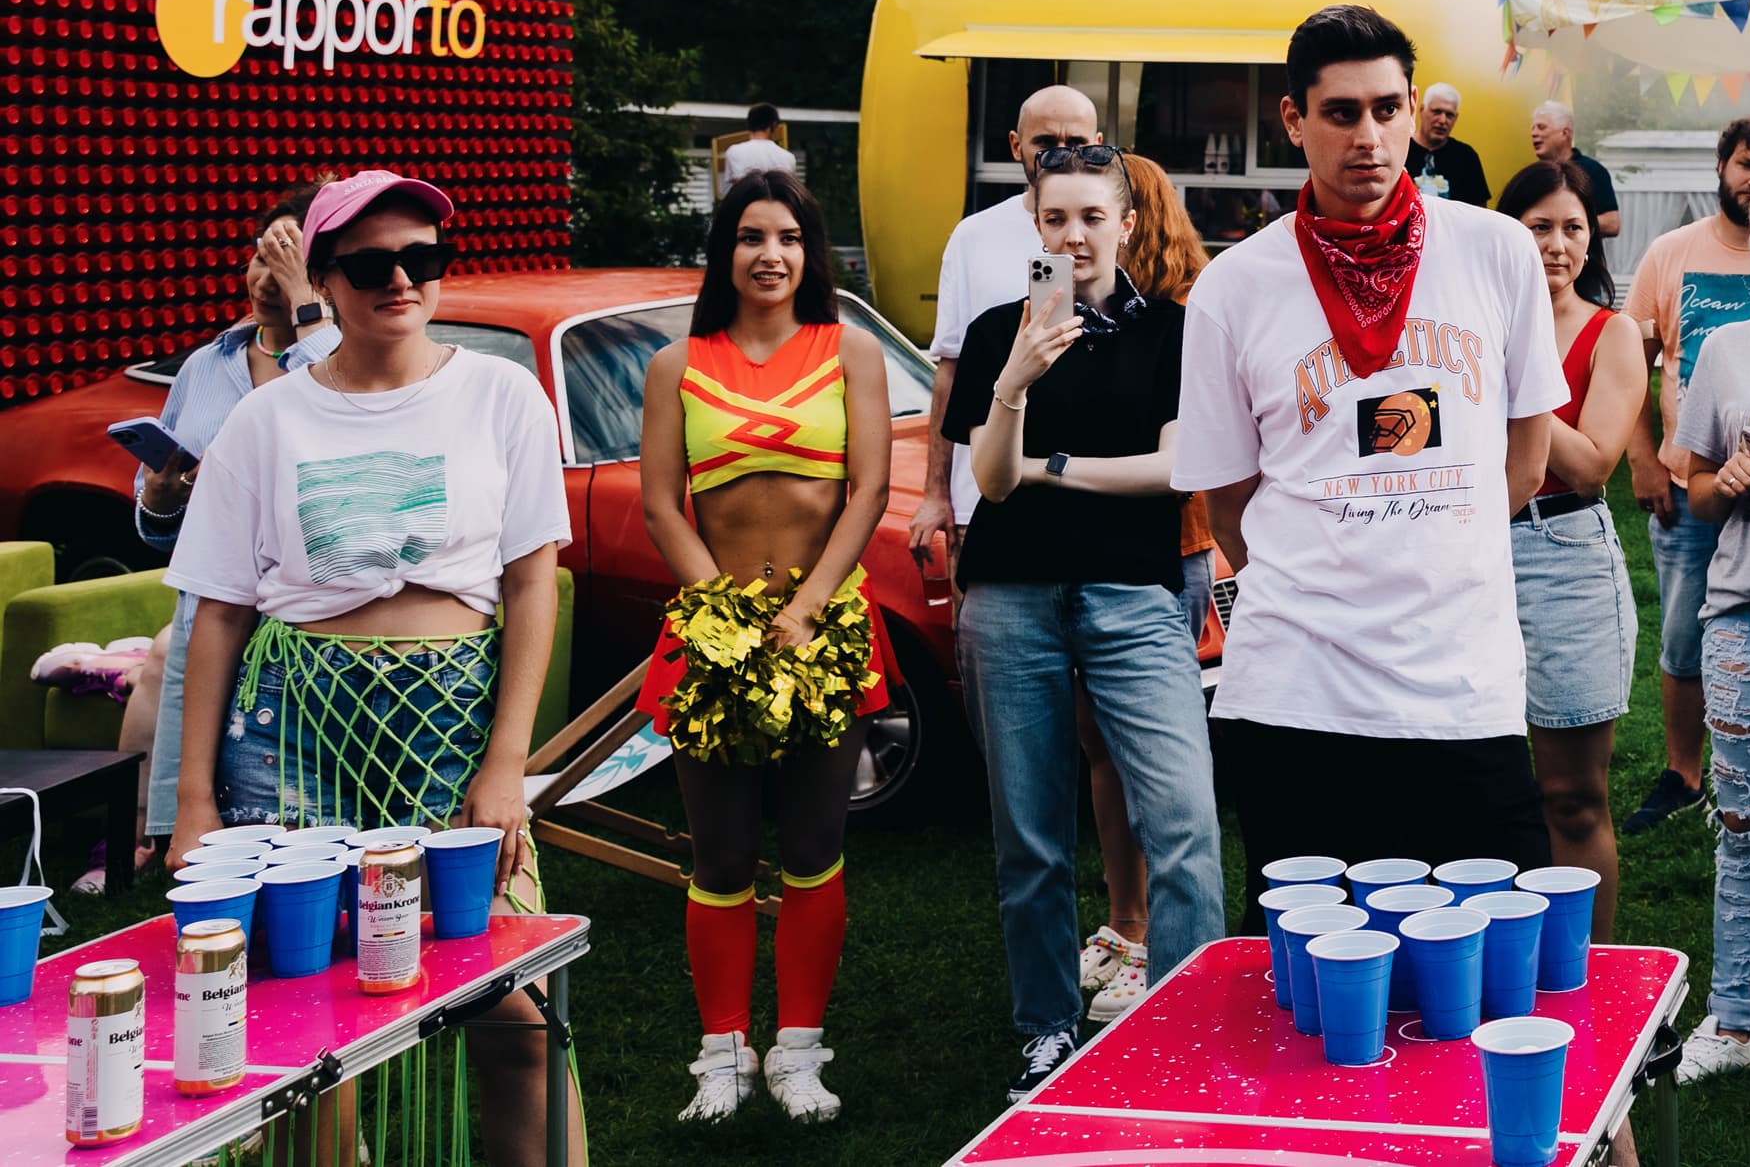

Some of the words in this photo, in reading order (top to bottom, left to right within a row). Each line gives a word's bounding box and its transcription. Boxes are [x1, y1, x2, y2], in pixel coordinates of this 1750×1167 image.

[1679, 284, 1746, 313] Ocean
[1294, 317, 1482, 435] ATHTICS
[1323, 477, 1360, 498] NEW
[1372, 473, 1418, 494] YORK
[1429, 468, 1463, 489] CITY
[1337, 502, 1376, 524] Living
[1382, 500, 1403, 521] The
[1408, 498, 1450, 520] Dream
[109, 1026, 144, 1045] Belgia
